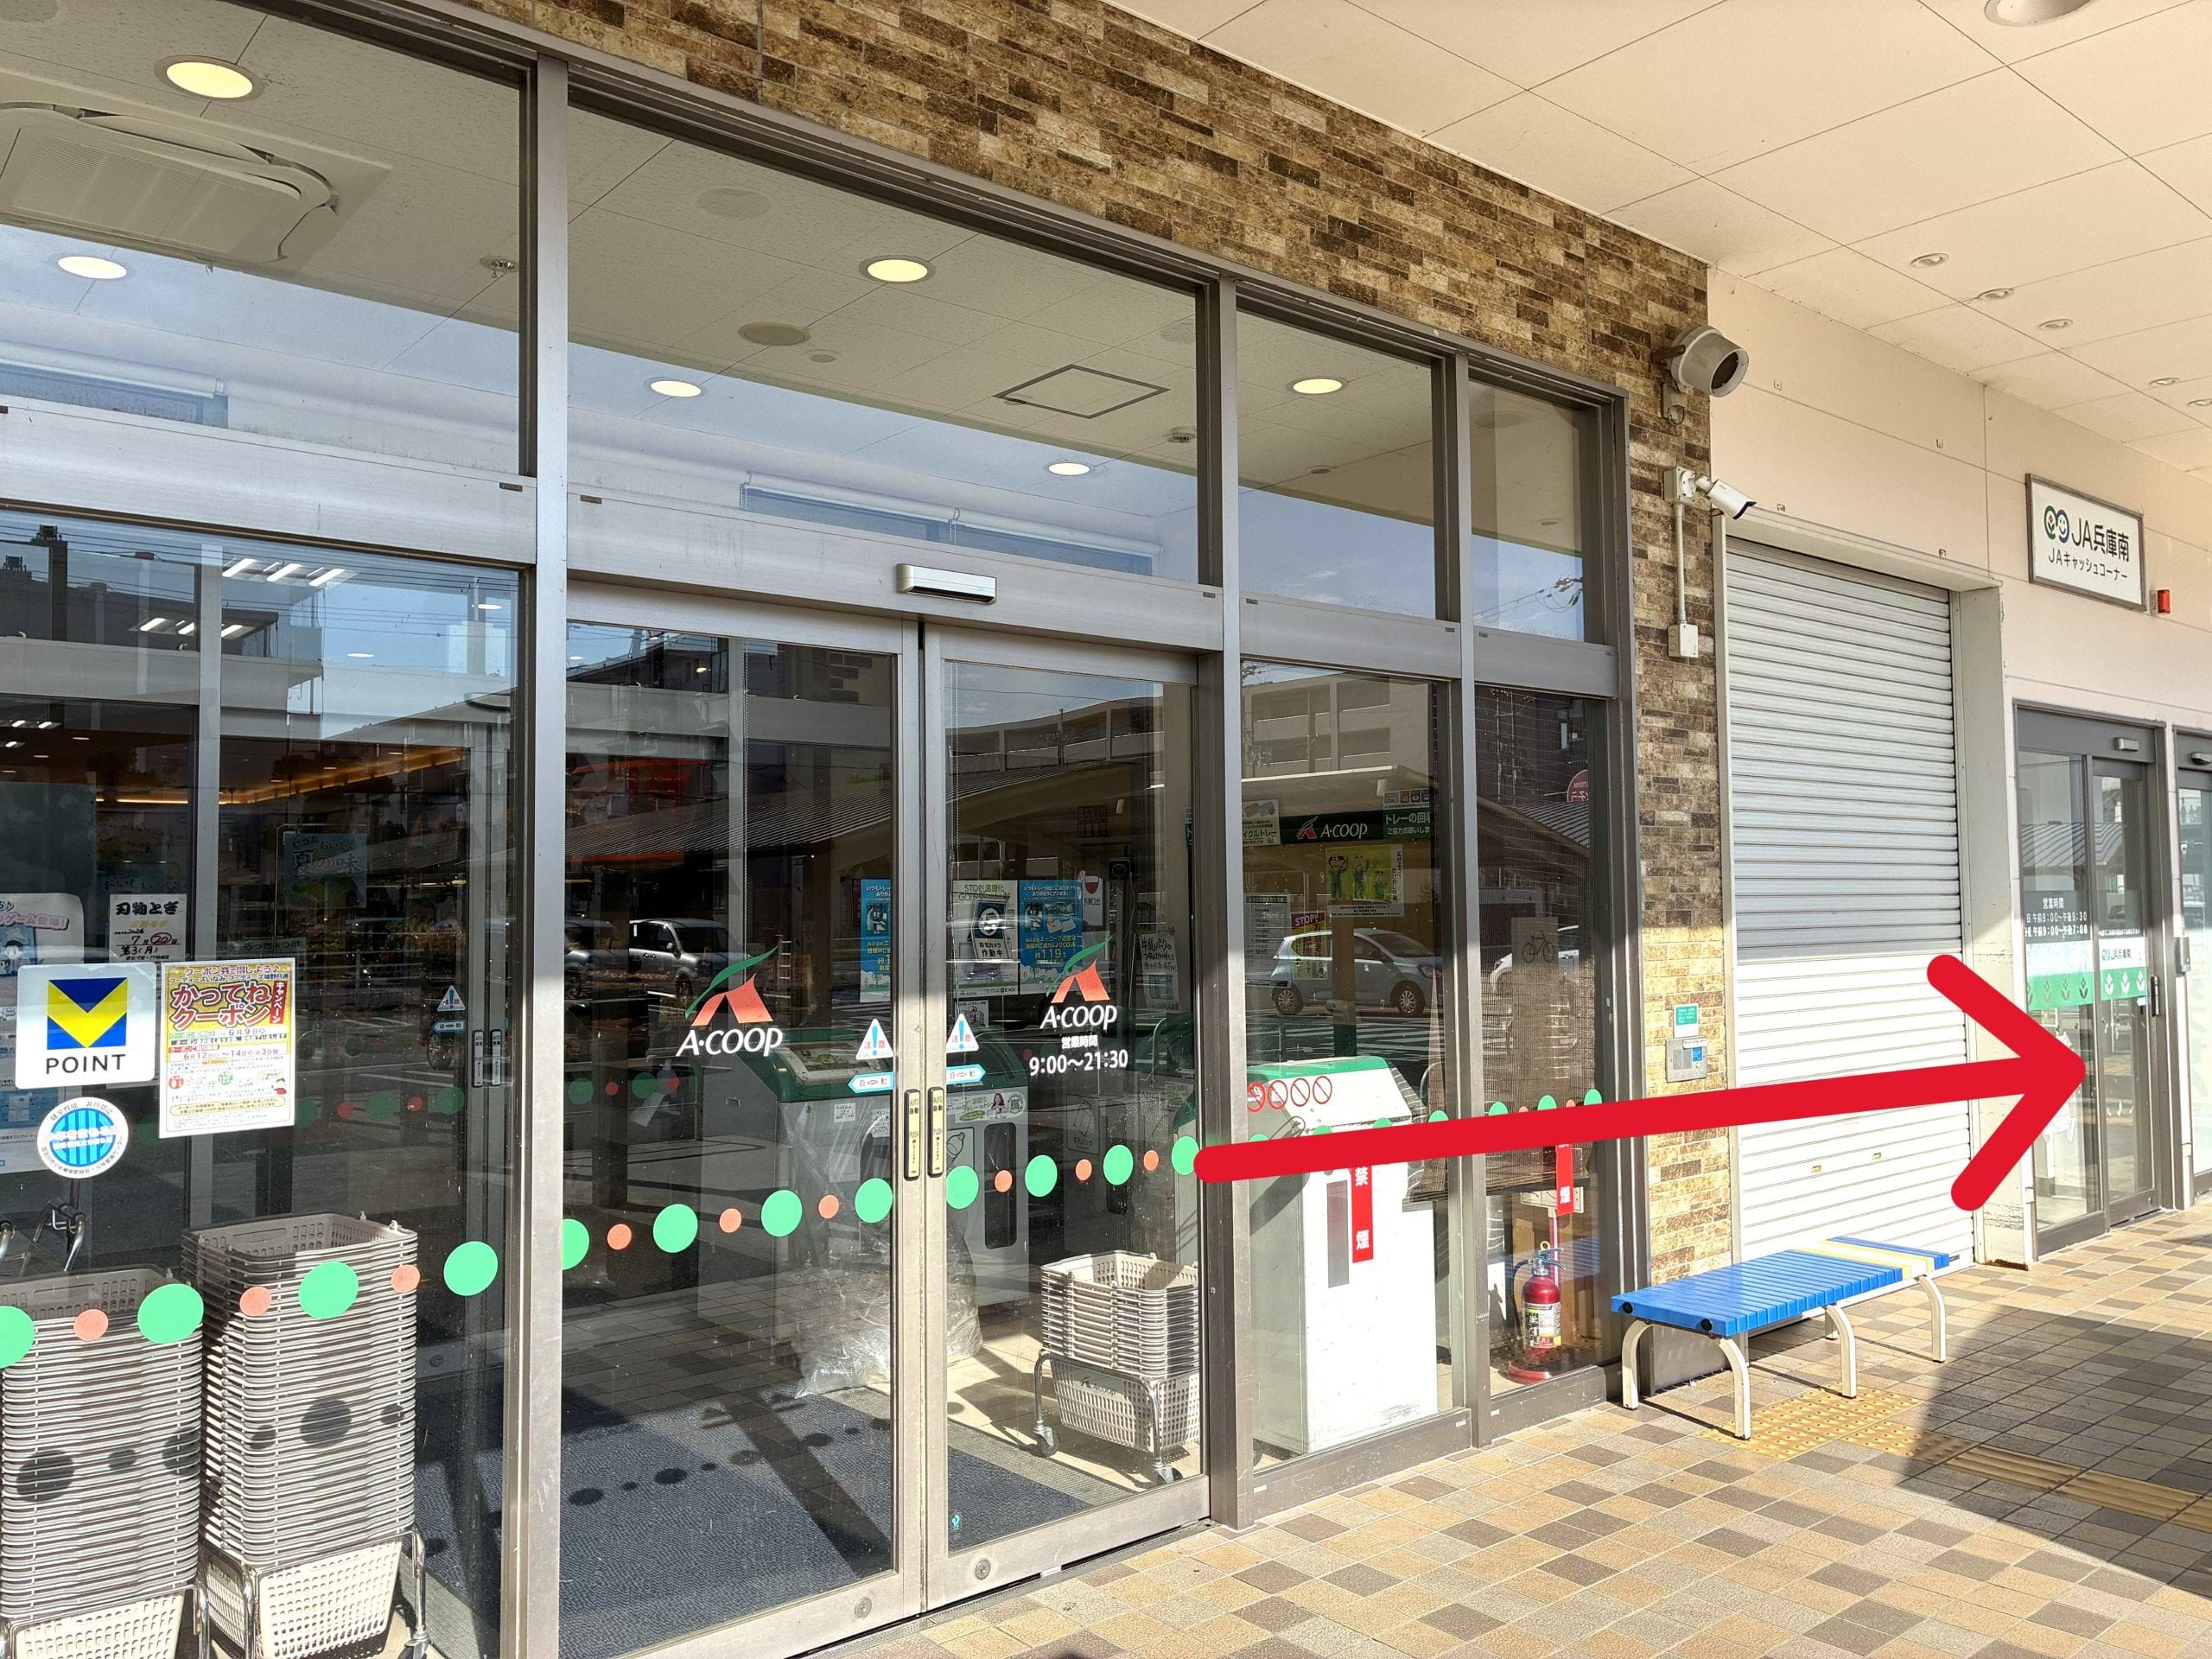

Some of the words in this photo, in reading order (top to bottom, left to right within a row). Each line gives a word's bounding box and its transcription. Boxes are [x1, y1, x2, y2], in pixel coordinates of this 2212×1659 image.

[2071, 518, 2130, 563] JA兵庫南
[2048, 547, 2128, 581] JAキャッシュコーナー
[115, 900, 179, 916] 刃物とぎ
[2043, 897, 2064, 910] 営業時間
[172, 981, 272, 1009] かってね
[171, 1002, 270, 1030] クーポン
[1061, 1034, 1098, 1050] 営業時間
[46, 1054, 126, 1075] POINT
